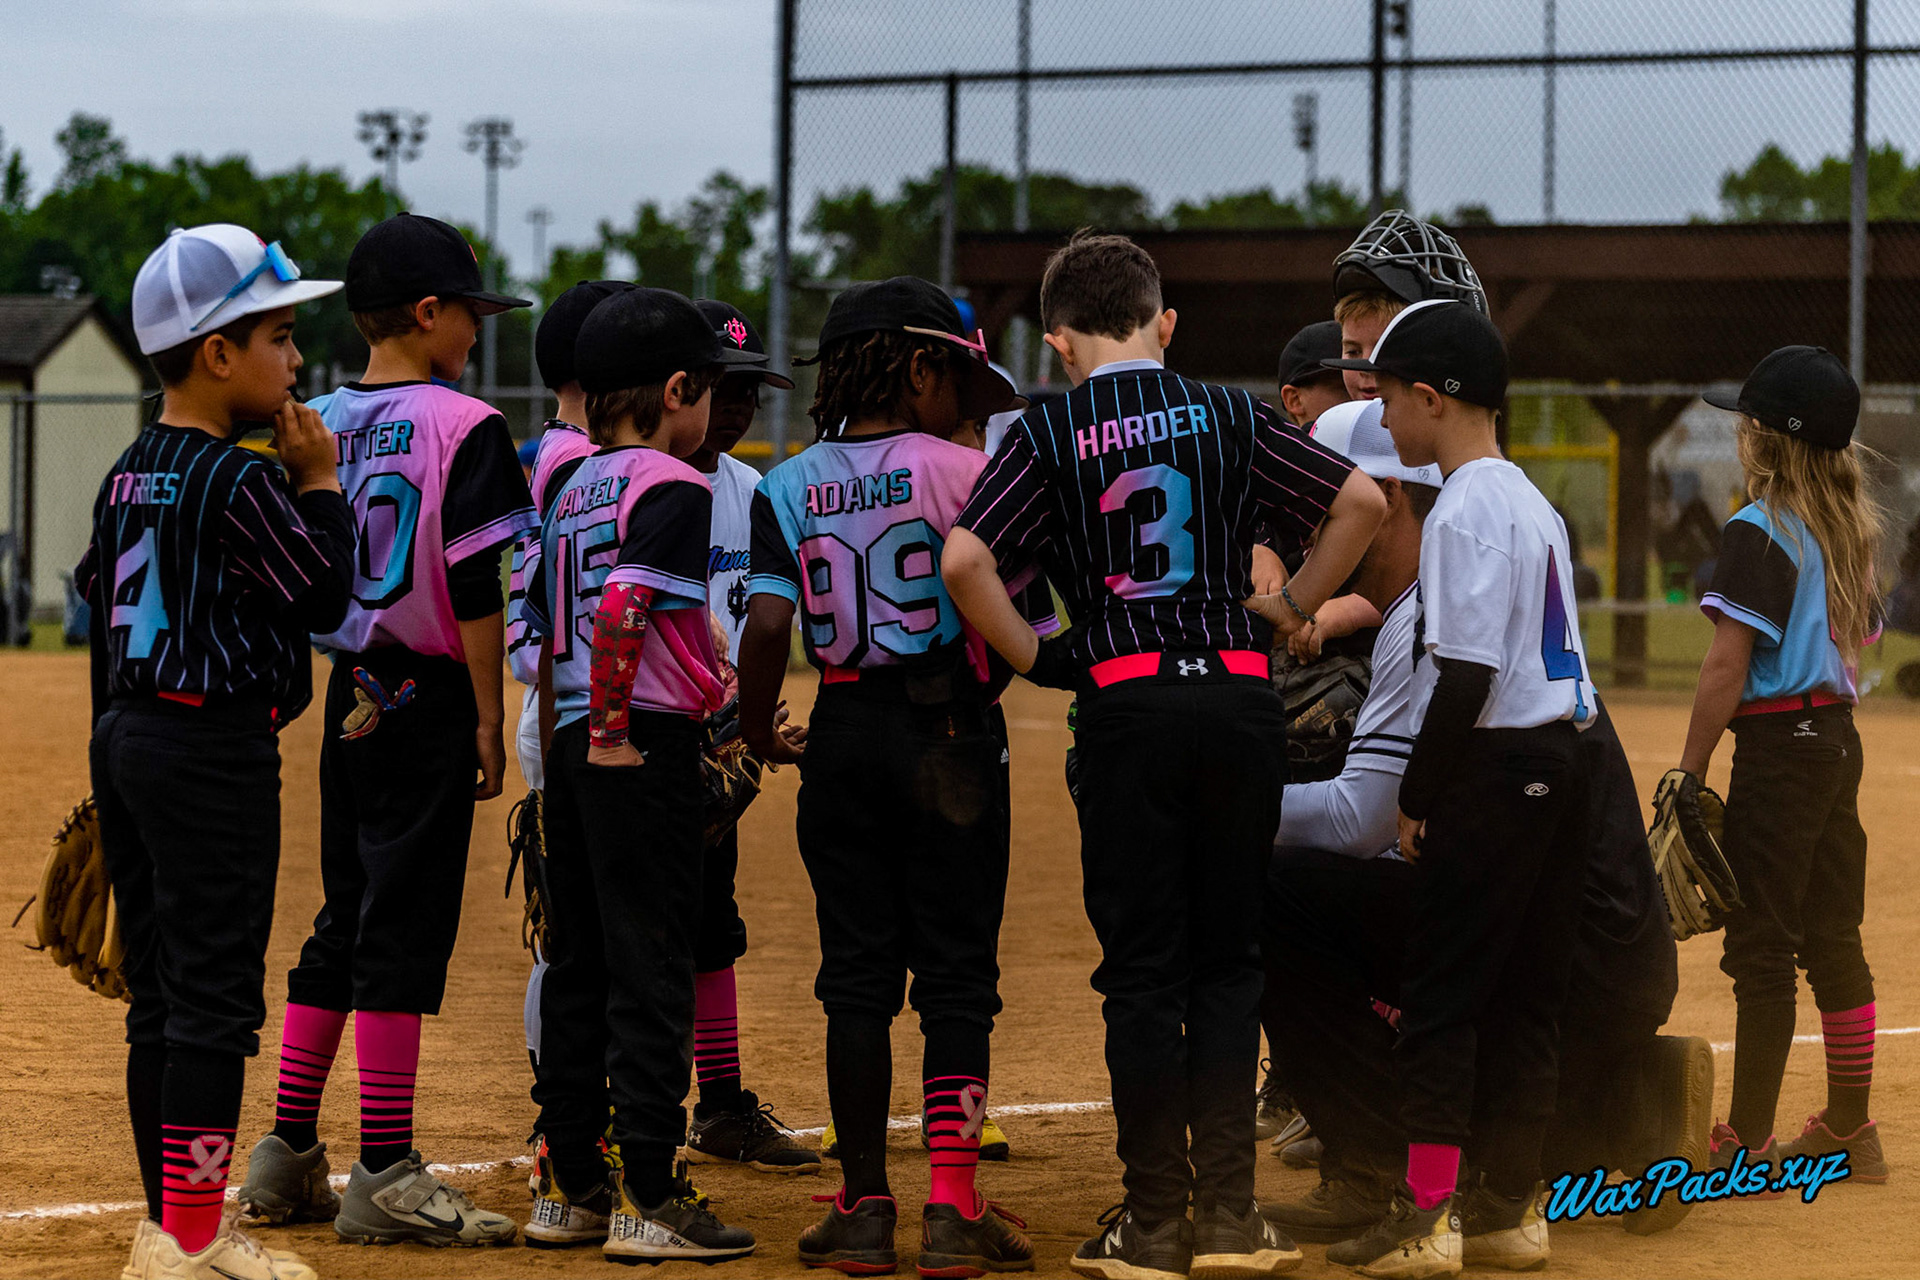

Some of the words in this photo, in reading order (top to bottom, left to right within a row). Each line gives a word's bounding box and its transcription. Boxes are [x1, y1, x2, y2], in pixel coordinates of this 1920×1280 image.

[109, 471, 181, 507] TORRES
[805, 467, 912, 519] ADAMS
[1076, 403, 1211, 462] HARDER
[110, 526, 171, 659] 4
[340, 471, 423, 611] 0
[797, 516, 963, 670] 99
[1099, 462, 1196, 600] 3
